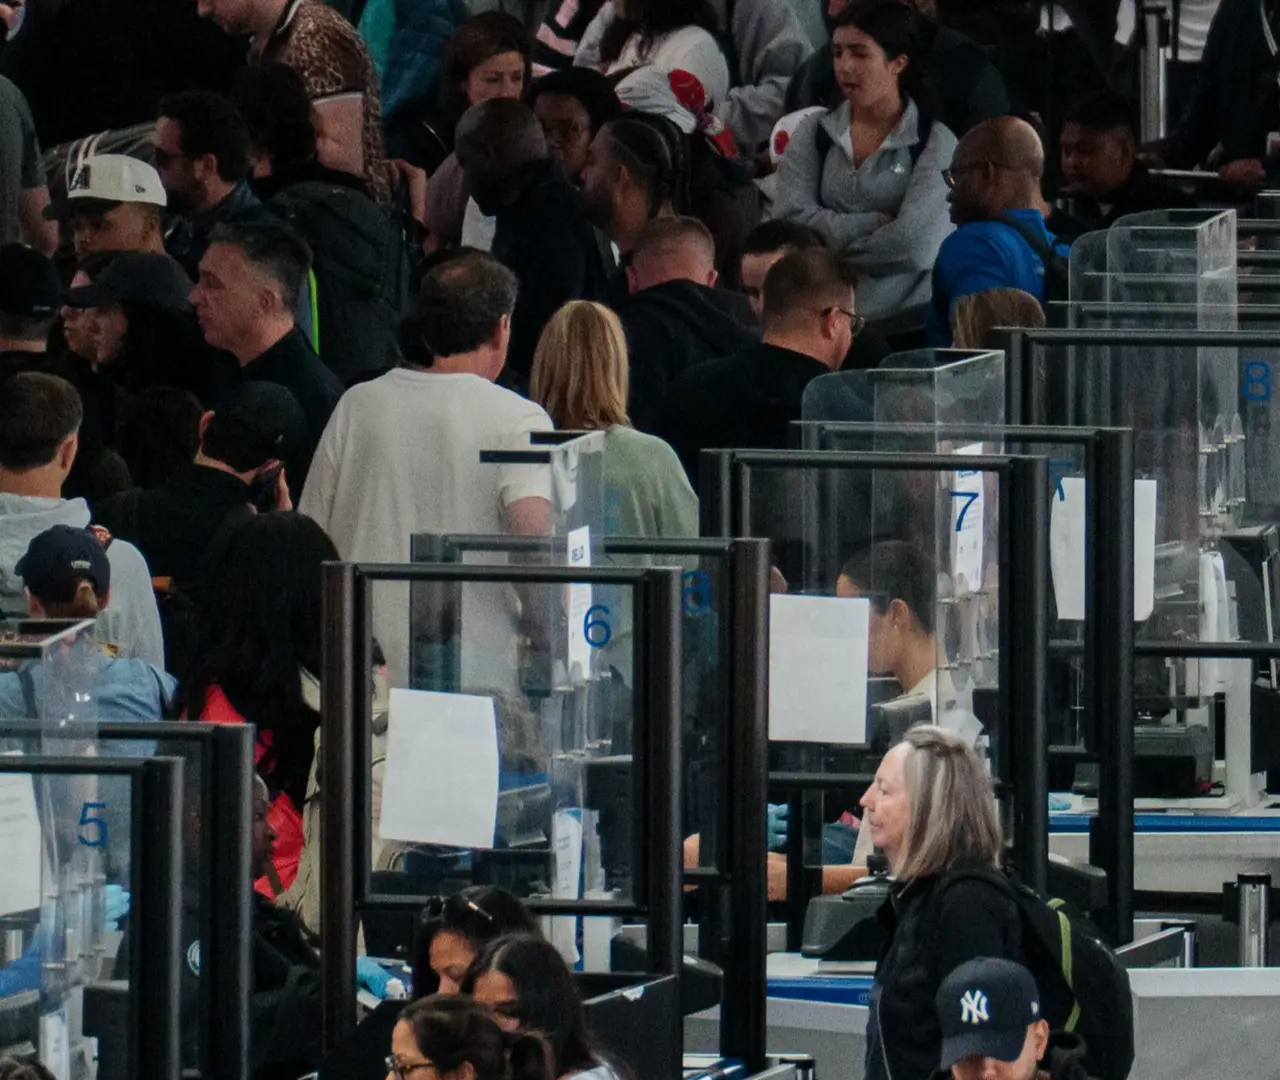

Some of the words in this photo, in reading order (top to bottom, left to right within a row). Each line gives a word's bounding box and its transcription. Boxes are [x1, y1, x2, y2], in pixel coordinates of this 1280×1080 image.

[1242, 361, 1272, 402] 8
[949, 490, 979, 532] 7
[583, 604, 612, 648] 6
[77, 802, 108, 848] 5
[960, 989, 989, 1024] NY
